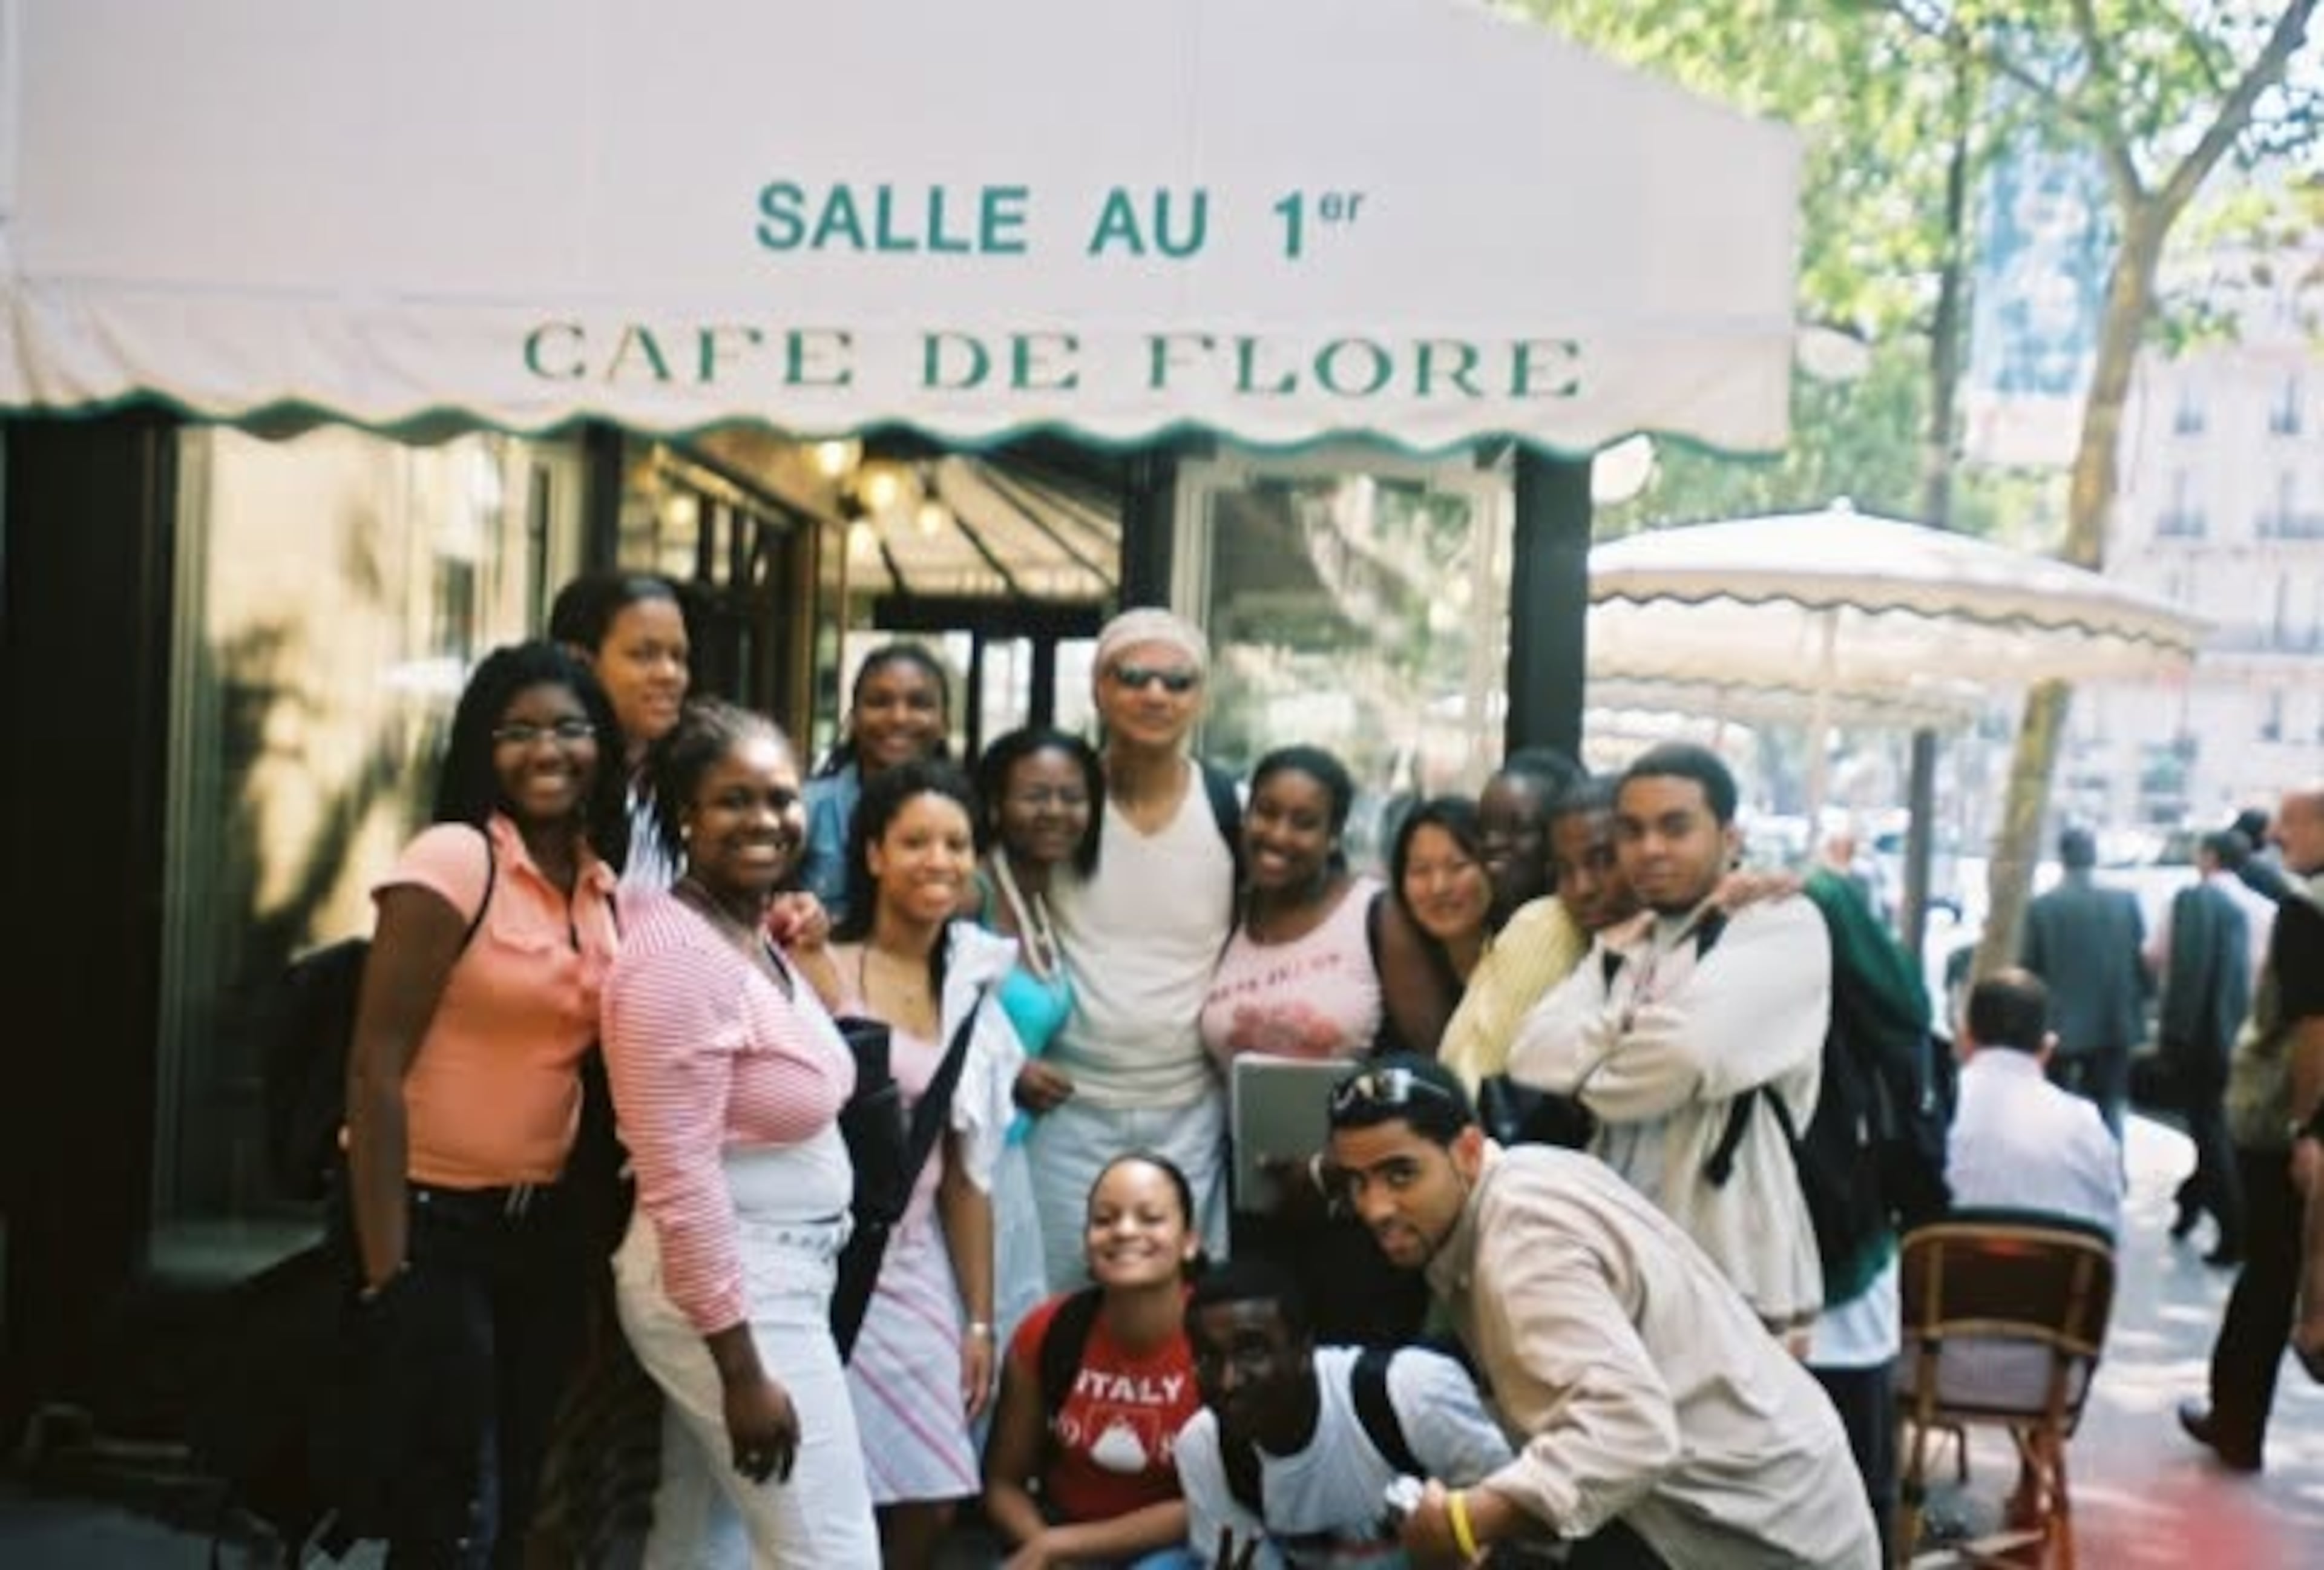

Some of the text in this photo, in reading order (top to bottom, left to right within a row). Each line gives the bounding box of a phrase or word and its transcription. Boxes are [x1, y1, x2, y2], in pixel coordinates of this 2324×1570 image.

[755, 181, 1029, 254] SALLE
[1088, 185, 1209, 258] AU
[524, 323, 1583, 399] CAFE DE FLORE
[1075, 1368, 1185, 1405] ITALY
